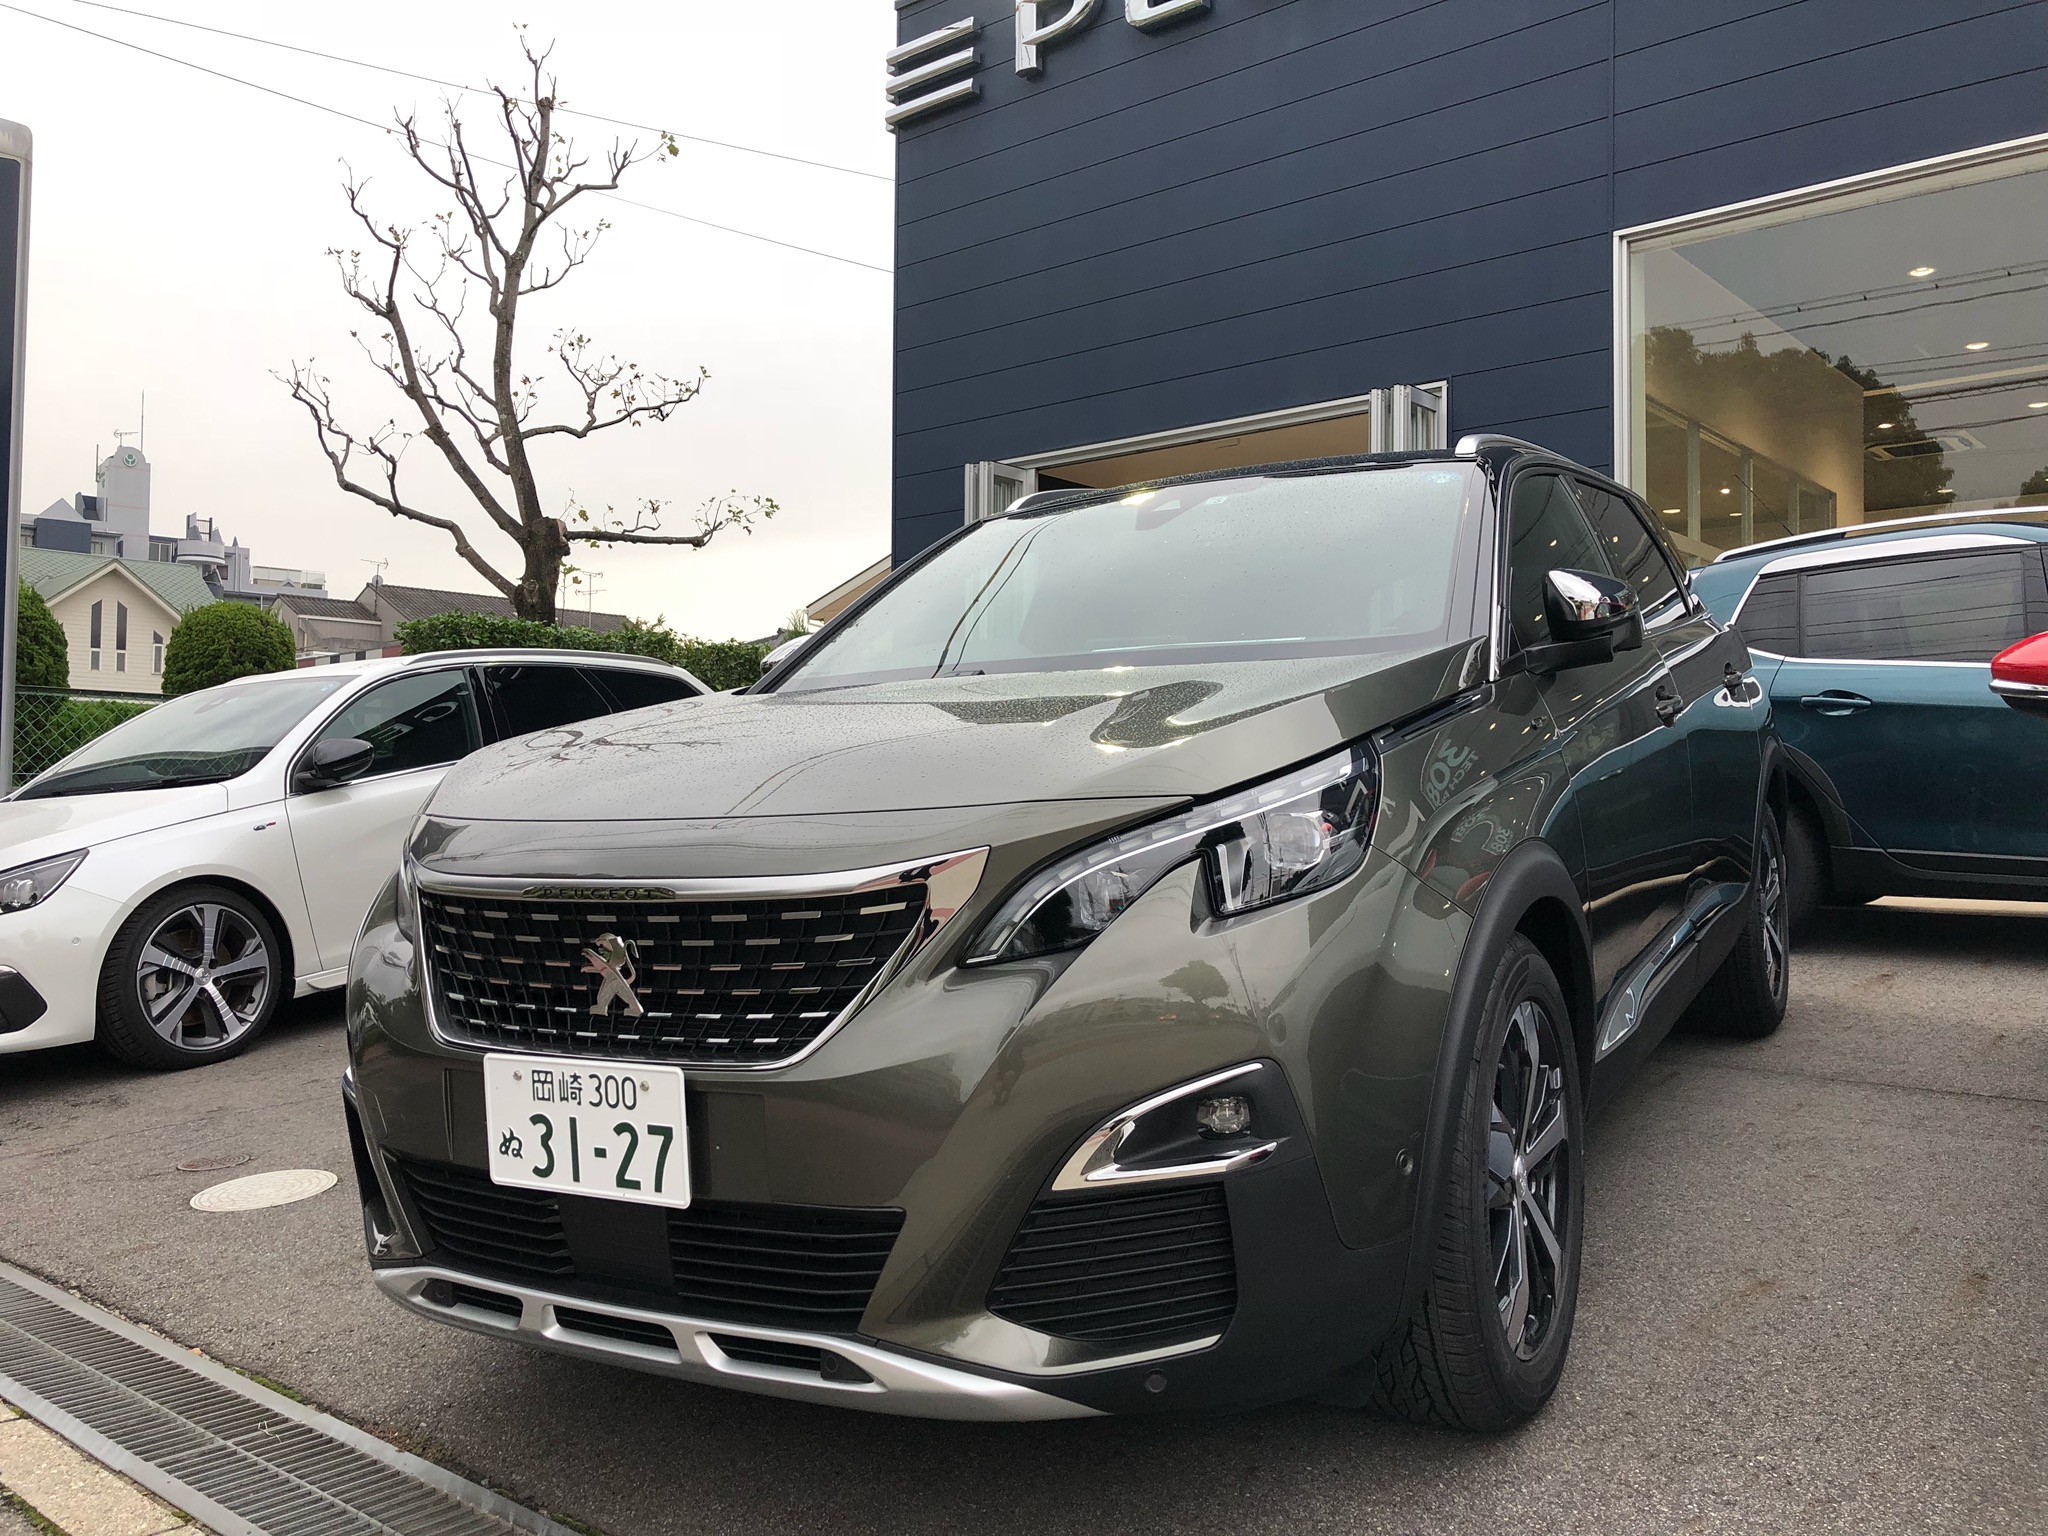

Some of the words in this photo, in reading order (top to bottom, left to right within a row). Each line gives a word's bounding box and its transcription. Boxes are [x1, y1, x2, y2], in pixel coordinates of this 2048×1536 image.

[543, 887, 655, 900] PEUGEOT
[531, 1069, 583, 1106] 岡崎
[588, 1073, 637, 1111] 300
[499, 1126, 524, 1160] ぬ
[528, 1113, 674, 1194] 31-27
